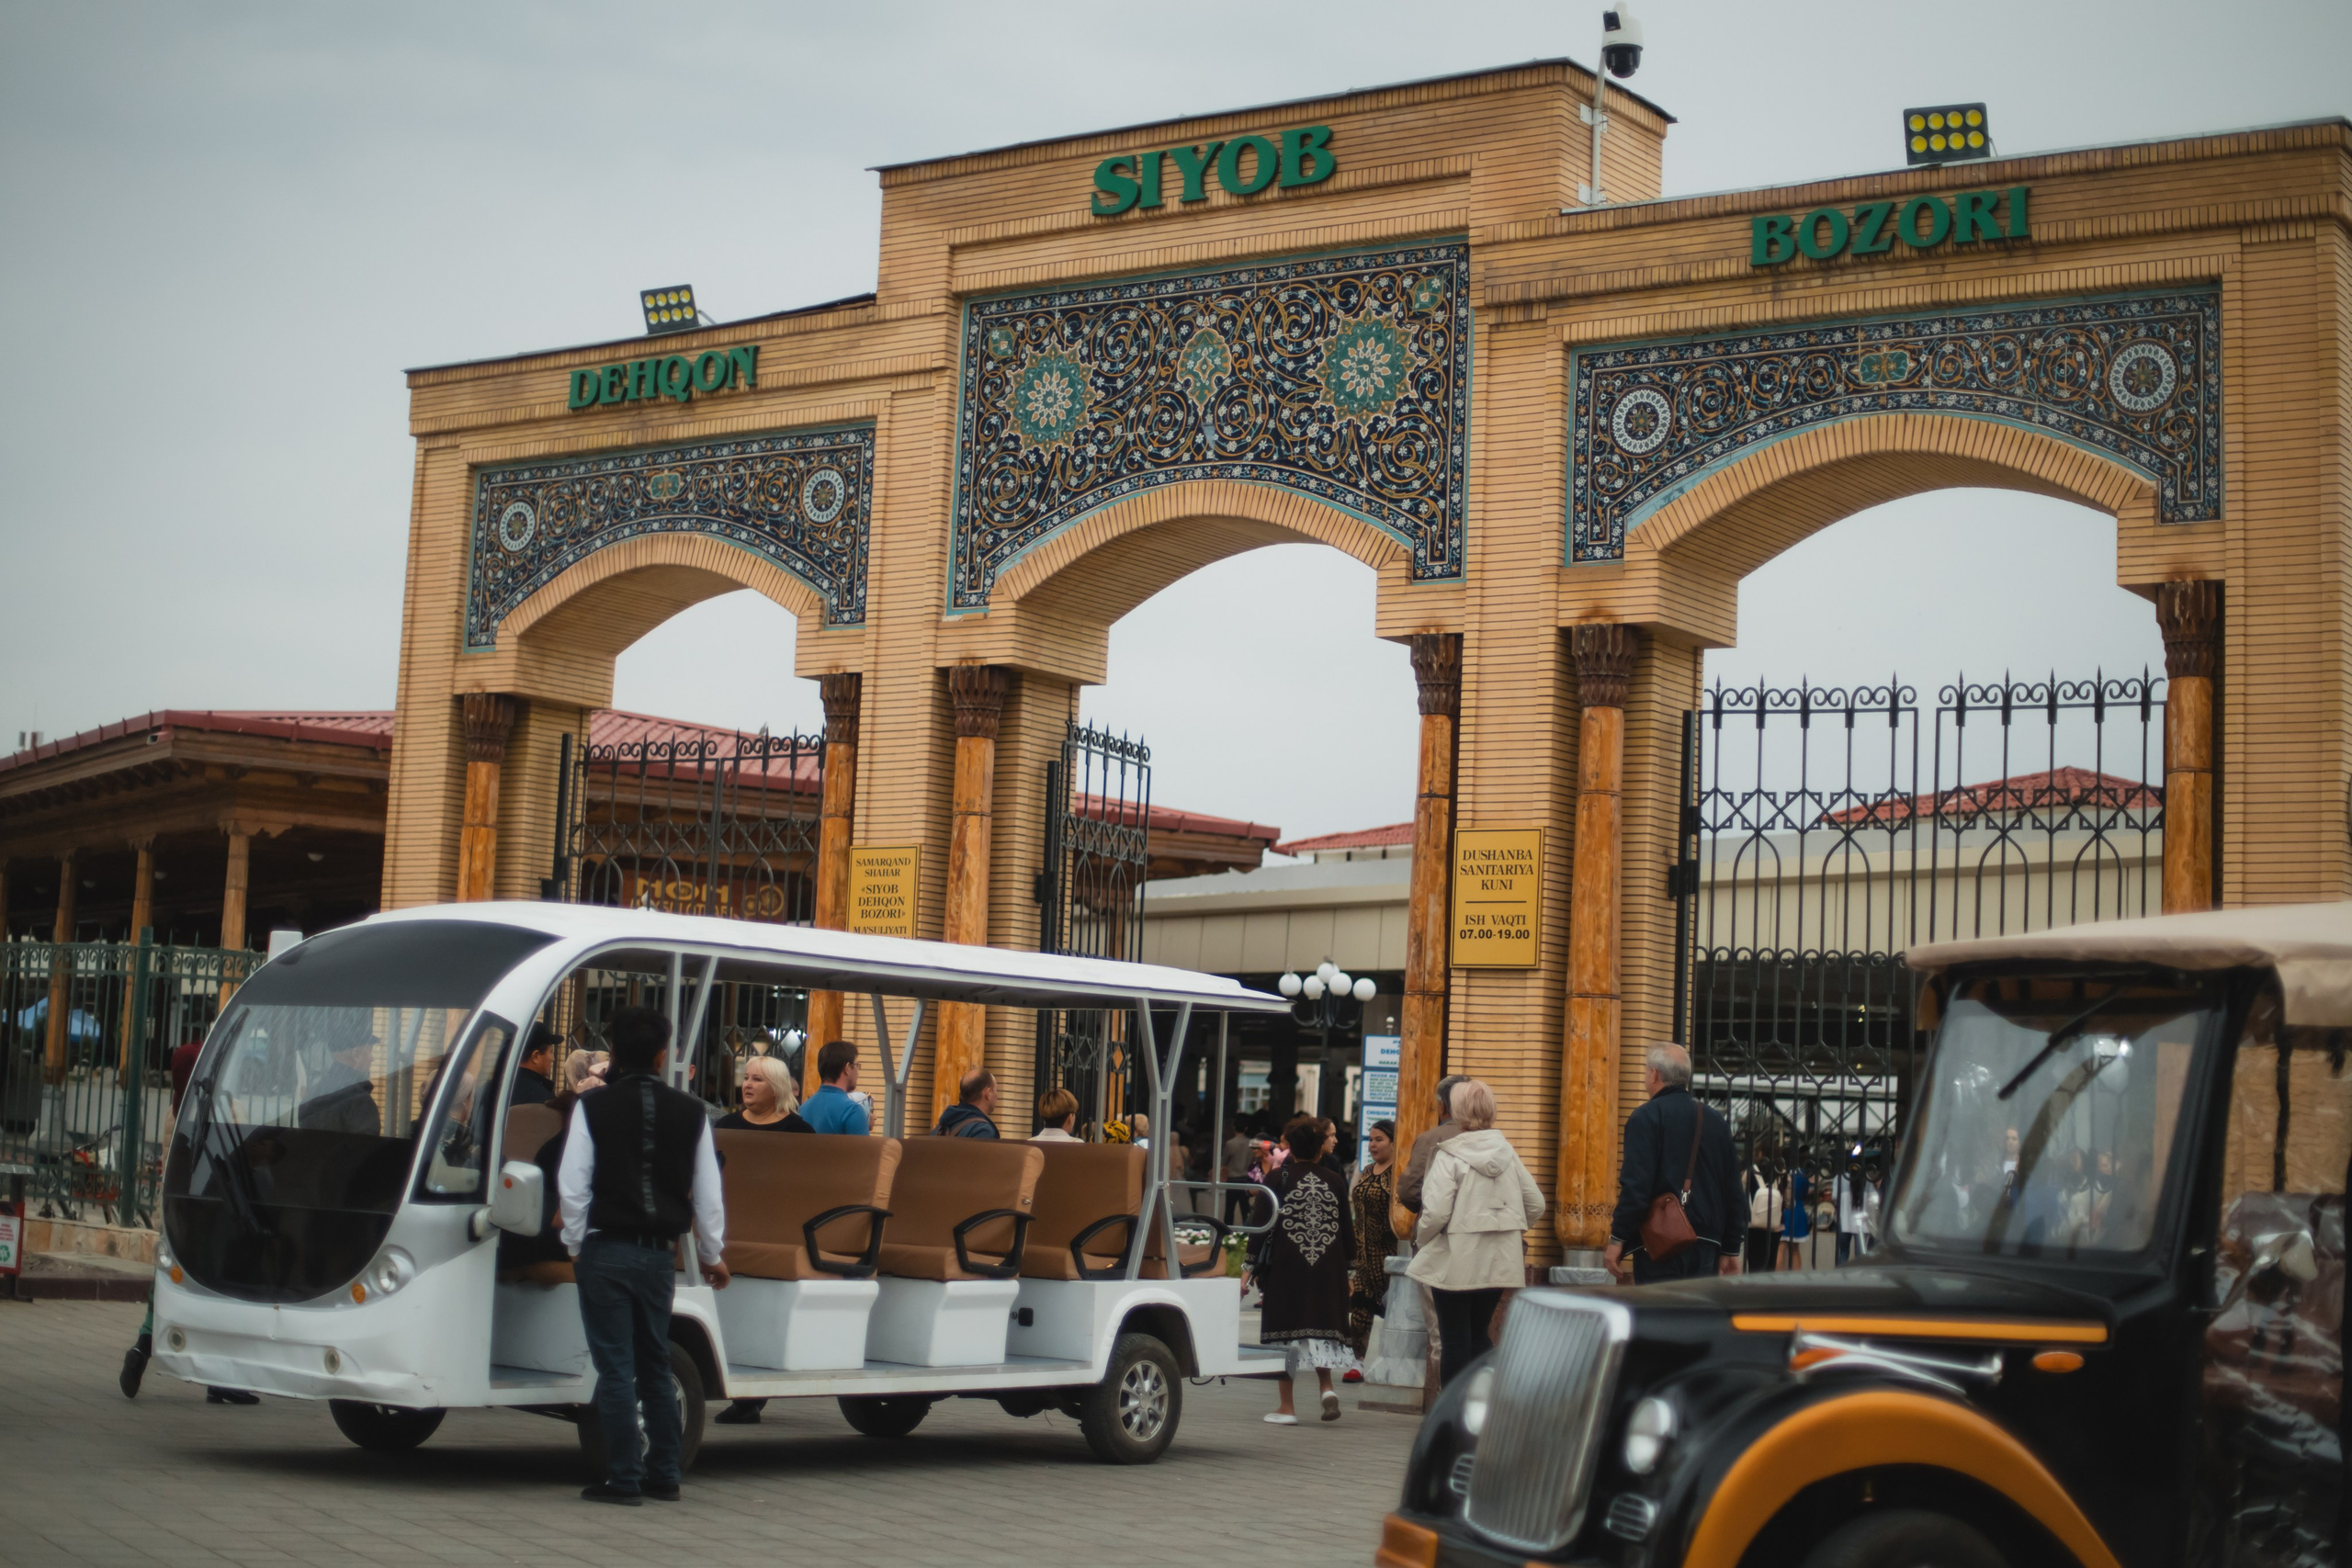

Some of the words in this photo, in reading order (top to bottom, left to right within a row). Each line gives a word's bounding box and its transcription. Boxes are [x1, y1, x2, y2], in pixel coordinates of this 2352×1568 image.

[1091, 125, 1337, 215] SIYOB
[1750, 186, 2030, 266] BOZORI
[568, 345, 760, 410] DEHQON
[1463, 849, 1533, 862] DUSHANBA
[855, 857, 911, 867] SAMARQAND
[865, 868, 901, 877] SHAHAR
[1460, 863, 1534, 875] SANITARIYA
[861, 884, 899, 895] «SIYOB
[1481, 879, 1513, 891] KUNI
[858, 896, 906, 908] DEHQON
[861, 908, 906, 919] BOZORI»
[1464, 914, 1486, 925] ISH
[1491, 914, 1526, 927] VAQTI
[1459, 929, 1530, 940] 07.00-19.00
